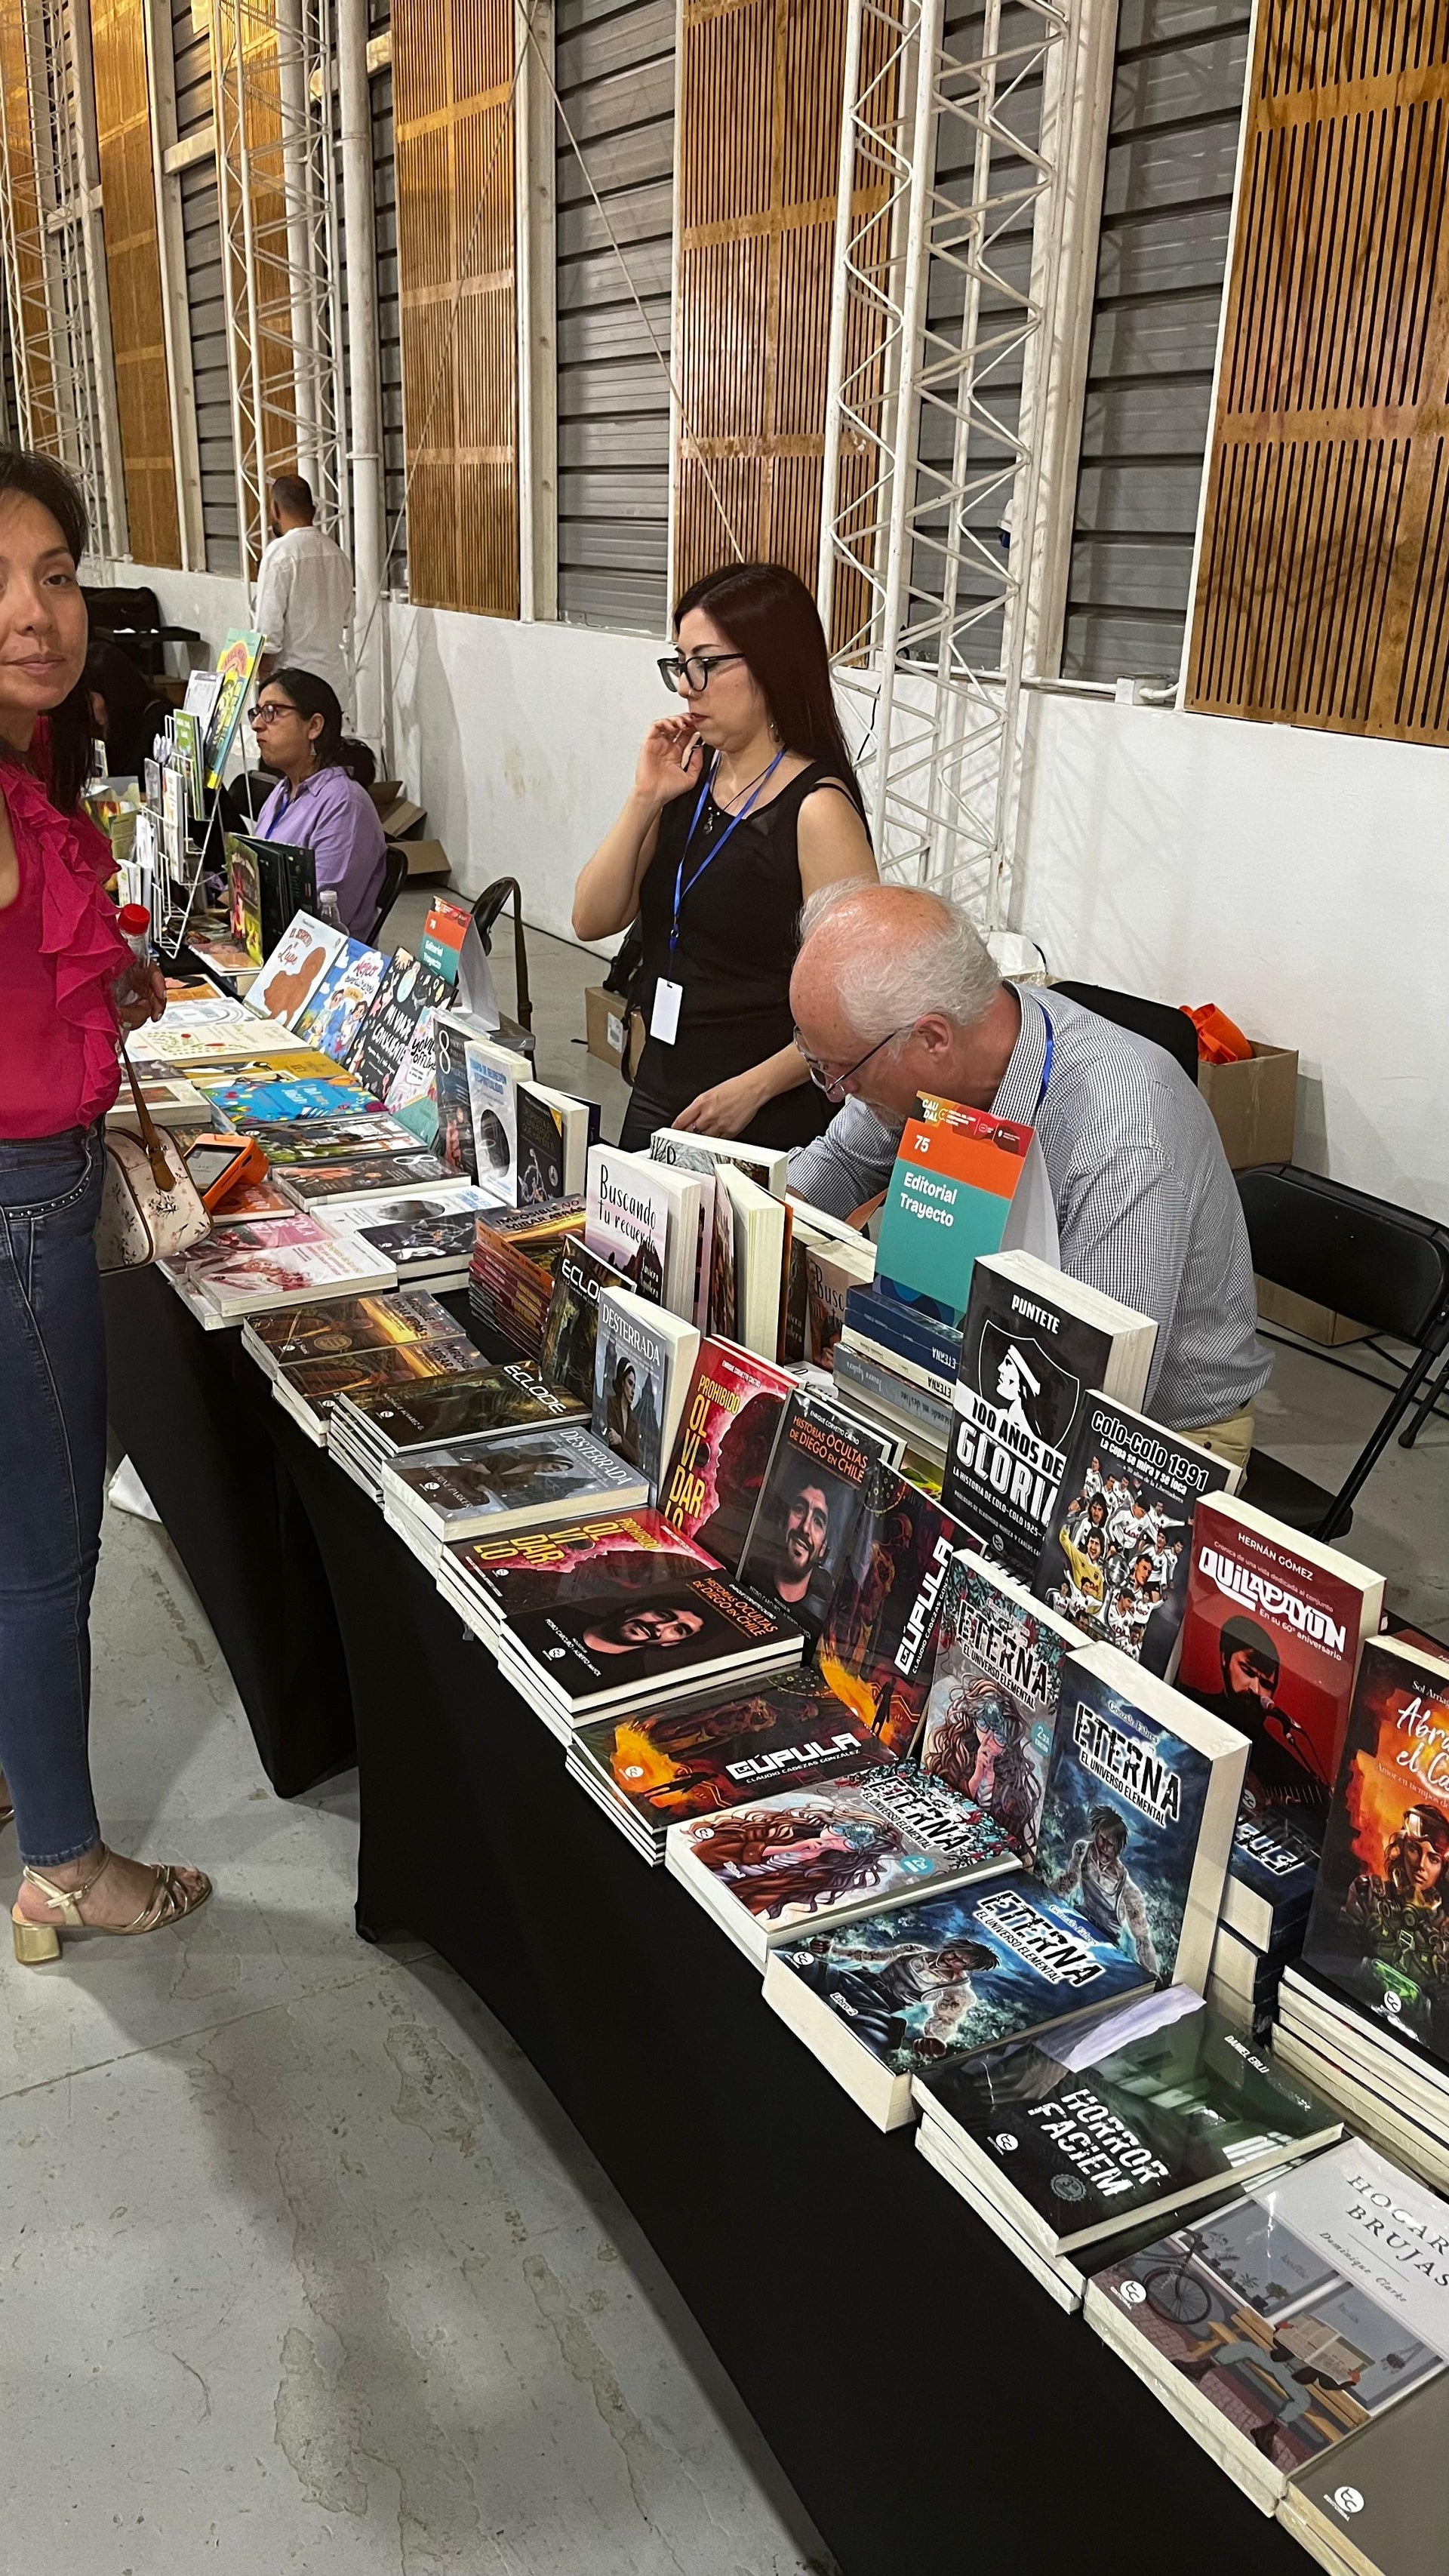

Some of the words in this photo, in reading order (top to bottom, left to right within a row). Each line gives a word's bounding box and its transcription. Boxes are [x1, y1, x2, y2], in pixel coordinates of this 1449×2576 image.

[922, 1098, 940, 1111] CAU
[914, 1134, 931, 1153] 75
[599, 1163, 657, 1230] Buscando
[899, 1191, 955, 1228] Trayecto
[903, 1171, 958, 1205] Editorial
[495, 1205, 561, 1225] IMPOSIBLE
[505, 1214, 548, 1230] MIRAR
[561, 1258, 601, 1303] ECLO
[601, 1303, 661, 1368] DESTERRADA
[1010, 1293, 1061, 1335] PUNTETE
[503, 1363, 568, 1415] ECLODE
[697, 1373, 741, 1415] PROHIBIDO
[689, 1394, 711, 1438] OL
[558, 1430, 634, 1486] DESTERRADA
[681, 1428, 700, 1471] VI
[789, 1428, 799, 1442] DE
[799, 1431, 828, 1459] DIEGO
[827, 1452, 838, 1467] EN
[838, 1457, 866, 1484] CHILE
[792, 1415, 826, 1443] HISTORIAS
[826, 1433, 869, 1470] OCULTAS
[971, 1396, 997, 1429] 100
[997, 1418, 1040, 1469] AÑOS
[1041, 1448, 1064, 1482] DE
[1109, 1442, 1128, 1461] copa
[1127, 1452, 1137, 1467] se
[1136, 1457, 1155, 1479] mira
[1161, 1473, 1171, 1486] se
[1168, 1453, 1211, 1493] 1991
[669, 1464, 706, 1519] DAR
[952, 1466, 960, 1479] LA
[959, 1470, 984, 1497] HISTORIA
[984, 1488, 992, 1503] DE
[991, 1495, 1024, 1527] COLO-COLO
[472, 1540, 519, 1561] LO
[509, 1533, 566, 1565] DAR
[582, 1521, 625, 1542] OL
[614, 1516, 664, 1551] PROHIBIDO
[1237, 1531, 1278, 1562] HERNÁN
[1278, 1554, 1314, 1582] GÓMEZ
[700, 1585, 733, 1610] DIEGO
[736, 1614, 767, 1637] CHILE
[734, 1600, 780, 1633] OCULTAS
[912, 1639, 928, 1675] CLAUDIO
[957, 1599, 1050, 1706] ETERNA
[1259, 1608, 1272, 1620] En
[1271, 1616, 1281, 1627] su
[1296, 1630, 1343, 1662] aniversario
[962, 1645, 972, 1659] EL
[971, 1650, 1001, 1684] UNIVERSO
[999, 1671, 1036, 1712] ELEMENTAL
[1412, 1680, 1426, 1694] Sol
[1108, 1700, 1136, 1729] Gonzalo
[1072, 1700, 1183, 1822] ETERNA
[1396, 1741, 1426, 1774] el
[1079, 1750, 1090, 1766] EL
[1088, 1758, 1125, 1796] UNIVERSO
[1123, 1780, 1167, 1827] ELEMENTAL
[1377, 1762, 1397, 1780] Amor
[1398, 1775, 1409, 1787] en
[1409, 1779, 1440, 1804] tiempos
[868, 1775, 973, 1852] ETERNA
[869, 1798, 901, 1824] UNIVERSO
[895, 1820, 933, 1850] ELEMENTAL
[976, 1889, 1108, 1990] ETERNA
[976, 1910, 989, 1922] EL
[983, 1917, 1023, 1953] UNIVERSO
[1017, 1947, 1061, 1984] ELEMENTAL
[831, 1993, 850, 2011] Libro
[1223, 2035, 1251, 2059] DANIEL
[1027, 2101, 1135, 2198] FACIEM
[1060, 2088, 1170, 2187] HORROR
[1320, 2230, 1373, 2275] Dominique
[1375, 2276, 1409, 2304] Clarke
[1344, 2202, 1449, 2288] BRUJAS
